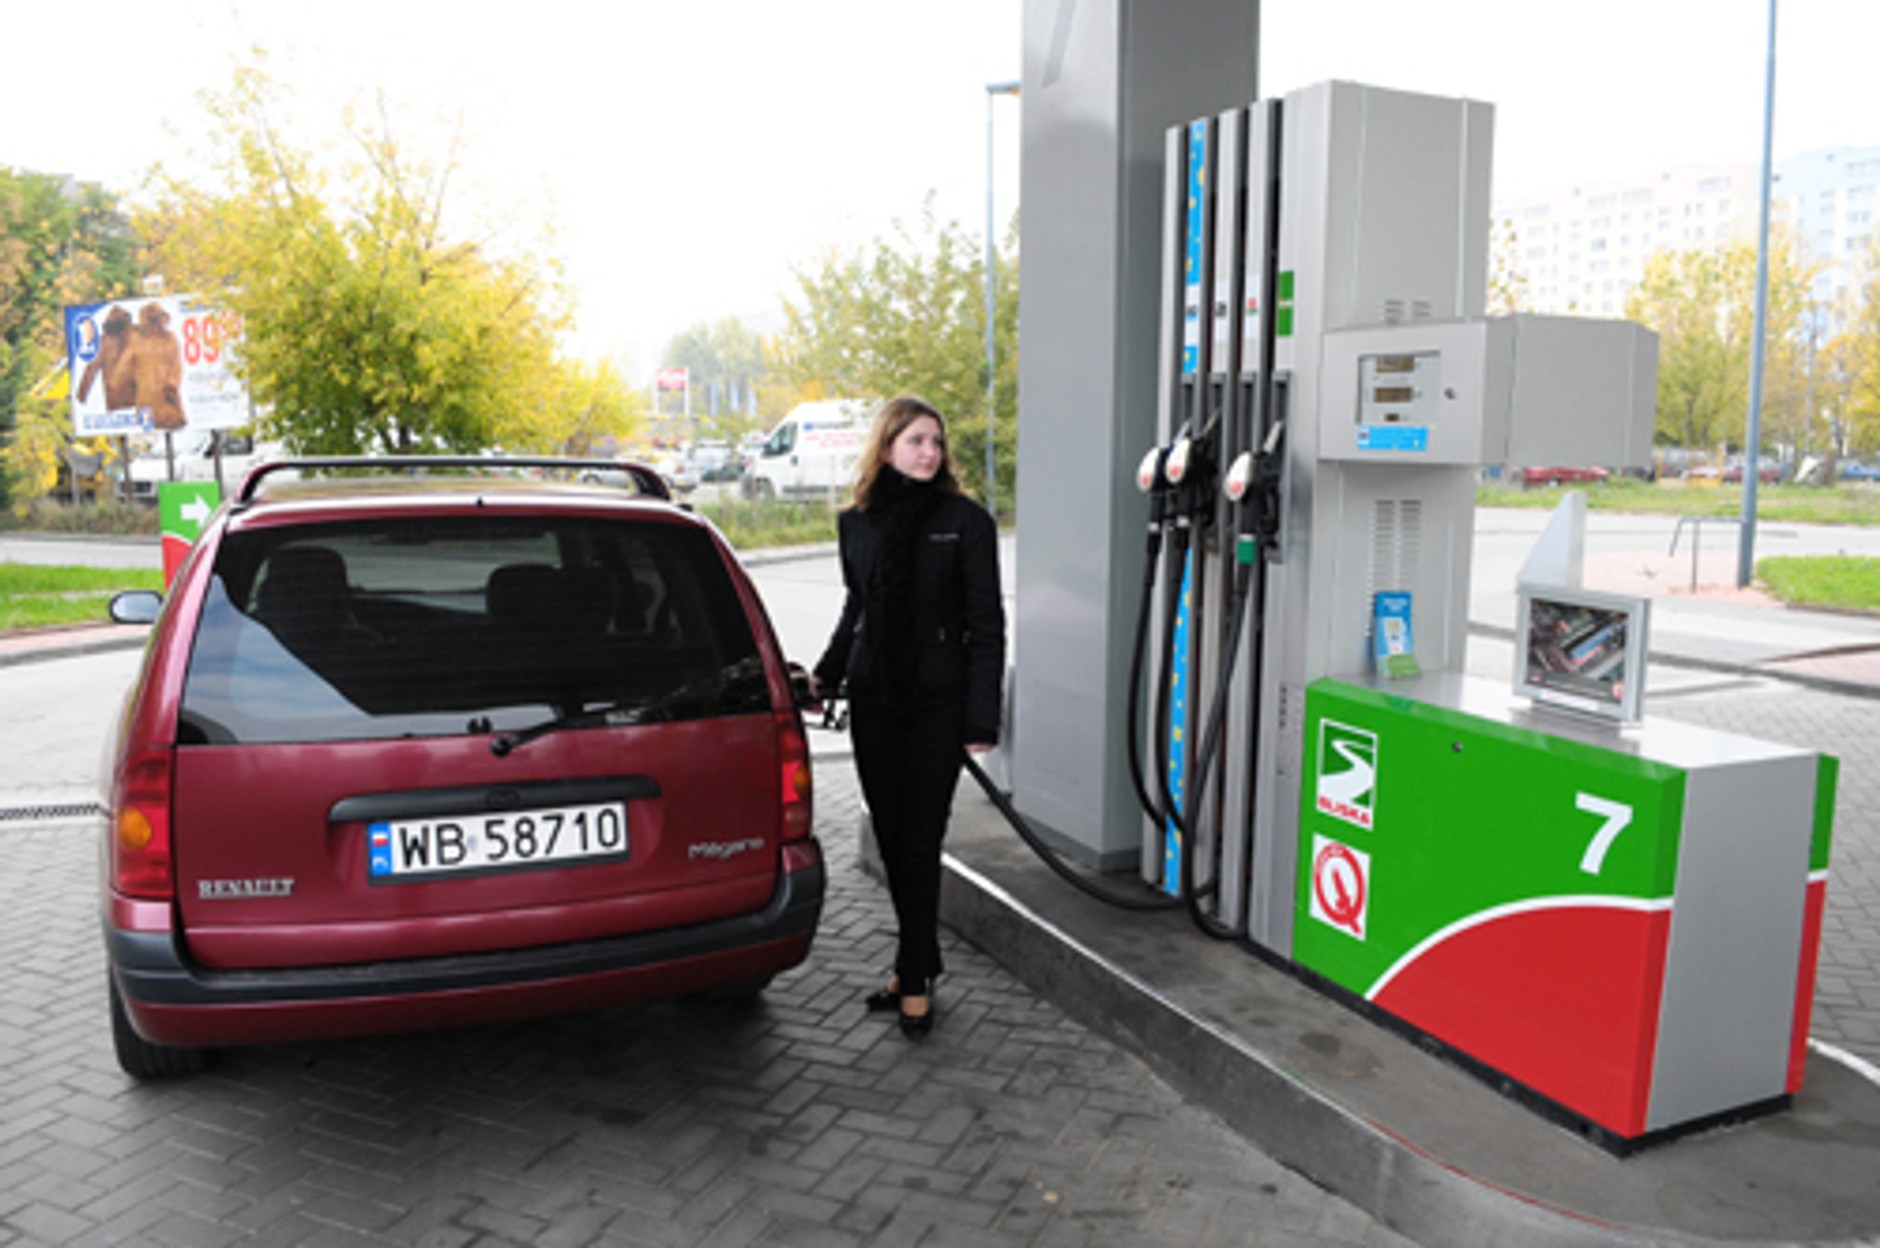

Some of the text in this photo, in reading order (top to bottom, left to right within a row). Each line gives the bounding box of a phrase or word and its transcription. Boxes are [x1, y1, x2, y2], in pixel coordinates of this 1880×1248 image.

[1317, 795, 1371, 826] BLISKA
[1575, 791, 1633, 875] 7
[399, 808, 621, 868] WB 58710
[198, 877, 296, 900] RENAULT
